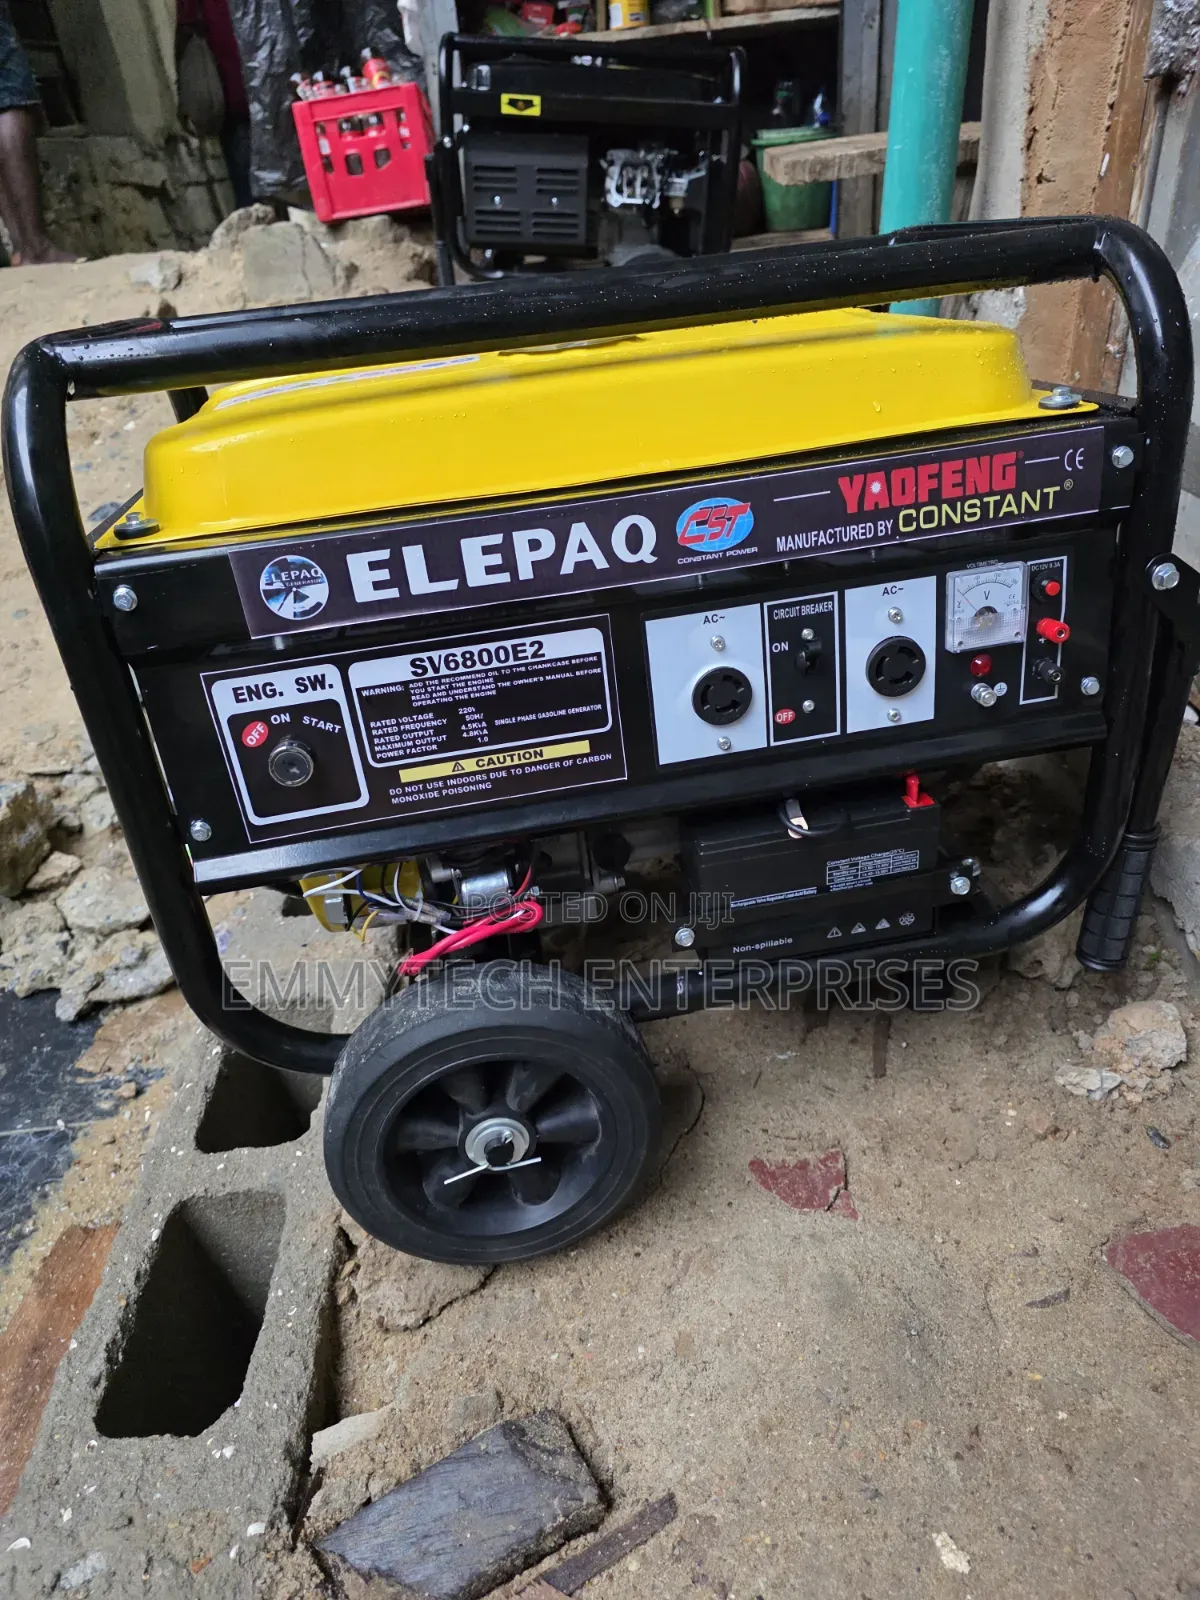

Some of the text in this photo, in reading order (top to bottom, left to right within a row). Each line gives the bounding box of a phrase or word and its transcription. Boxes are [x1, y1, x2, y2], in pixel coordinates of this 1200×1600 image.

[1064, 448, 1084, 471] CE
[838, 451, 1016, 513] YAOFENG
[677, 502, 751, 546] CST
[776, 486, 1060, 553] MANUFACTURED BY CONSTANT
[346, 514, 658, 603] ELEPAQ
[677, 547, 758, 564] CONSTANT POWER
[264, 568, 322, 583] ELEPAQ
[984, 590, 990, 601] V
[773, 601, 833, 620] CIRCUIT BREAKER
[772, 641, 788, 653] ON
[409, 640, 545, 677] SV6800E2
[441, 673, 486, 683] RECOMMEND
[572, 656, 598, 665] BEFORE
[232, 674, 334, 703] ENG. SW.
[361, 685, 404, 697] WARNING:
[411, 693, 430, 701] READ
[449, 684, 495, 696] UNDERSTAND
[513, 676, 543, 686] OWNER'S
[546, 672, 574, 681] MANUAL
[576, 668, 601, 676] BEFORE
[427, 684, 449, 692] START
[468, 678, 494, 687] ENGINE
[412, 697, 453, 707] OPERATING
[470, 690, 496, 698] ENGINE
[270, 713, 291, 724] ON
[370, 719, 396, 728] RATED
[398, 713, 434, 723] VOLTAGE
[494, 704, 602, 726] SINGLE PHASE GASOLINE GENERATOR
[776, 711, 793, 723] OFF
[302, 716, 341, 733] START
[372, 726, 398, 735] RATED
[400, 718, 447, 730] FREQUENCY
[246, 723, 265, 745] OFF
[374, 735, 400, 744] RATED
[402, 729, 434, 740] OUTPUT
[374, 740, 413, 752] MAXIMUM
[415, 735, 447, 746] OUTPUT
[376, 750, 404, 759] POWER
[406, 744, 438, 754] FACTOR
[475, 749, 544, 769] CAUTION
[389, 753, 612, 796] DO NOT USE INDOORS DUE TO DANGER OF CARBON
[391, 782, 492, 805] MONOXIDE POISONING
[732, 937, 793, 953] Non-spillable
